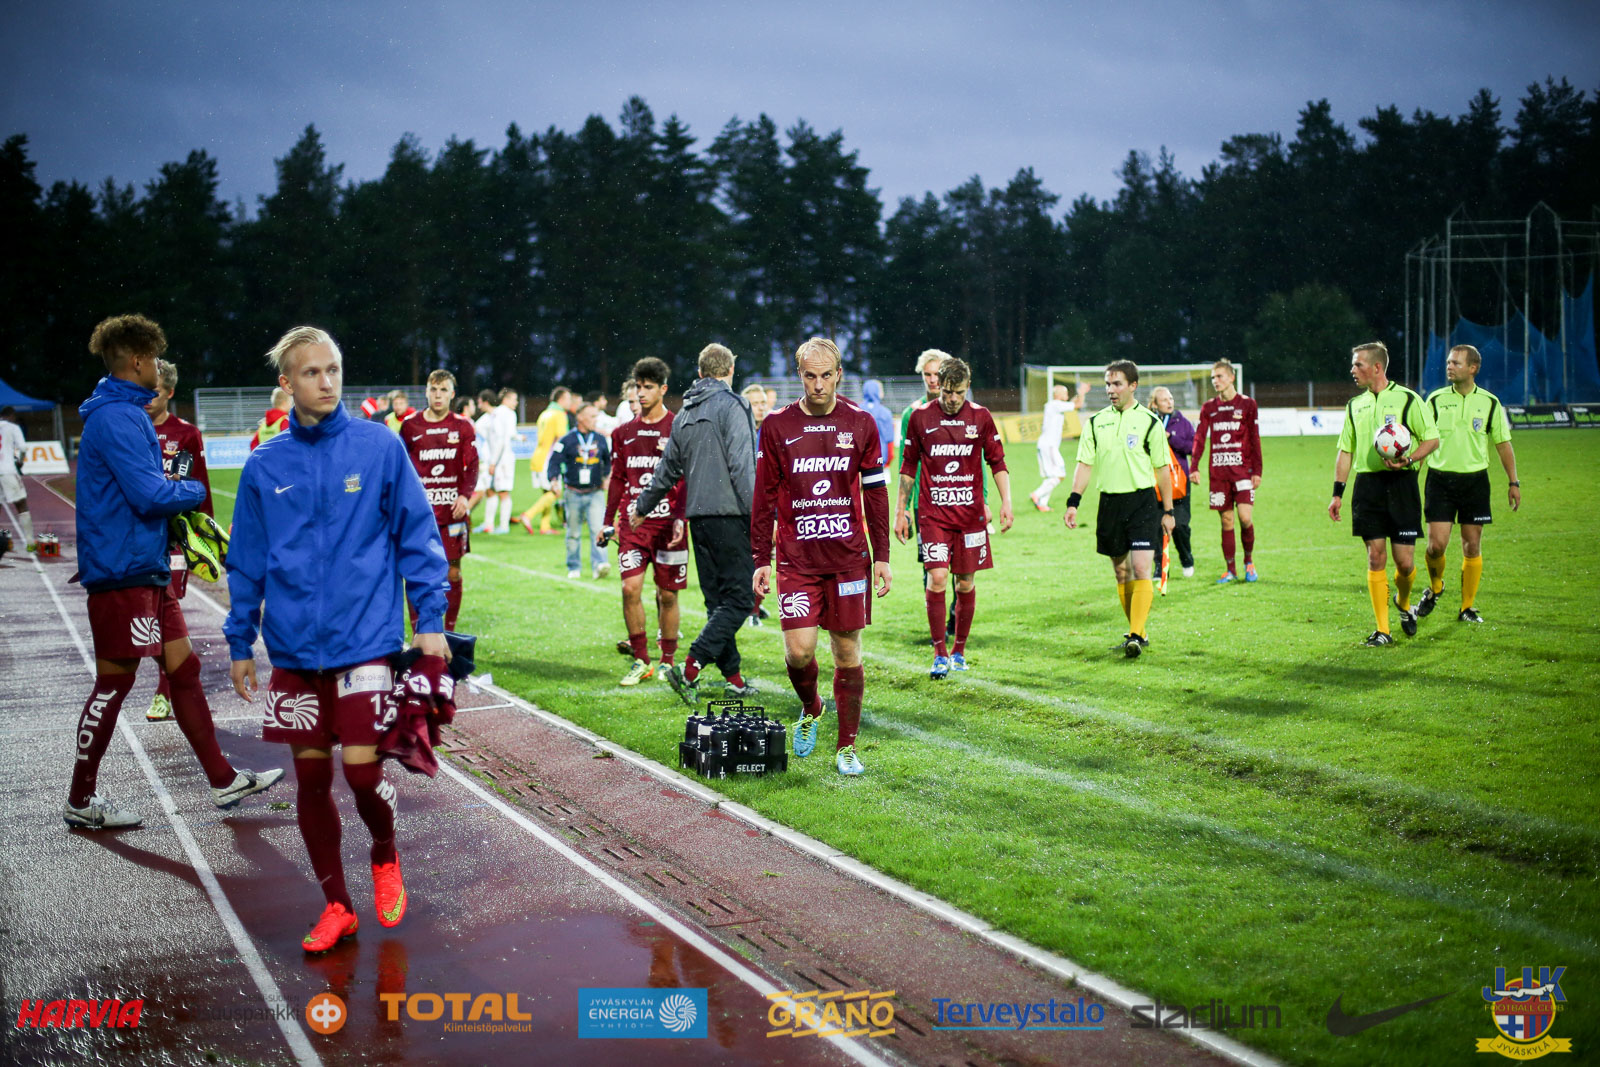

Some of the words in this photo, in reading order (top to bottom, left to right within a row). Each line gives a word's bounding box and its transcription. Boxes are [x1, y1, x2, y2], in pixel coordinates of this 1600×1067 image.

[803, 425, 837, 433] stadium
[939, 419, 965, 427] stadium
[419, 447, 457, 461] HARVIA
[930, 444, 974, 456] HARVIA
[626, 455, 662, 469] HARVI
[792, 456, 851, 474] HARVIA
[427, 491, 459, 501] RANO
[931, 490, 973, 502] GRANO
[796, 517, 851, 536] GRANO
[679, 564, 687, 577] 9
[76, 689, 118, 761] TOTAL
[736, 763, 766, 773] SELECT
